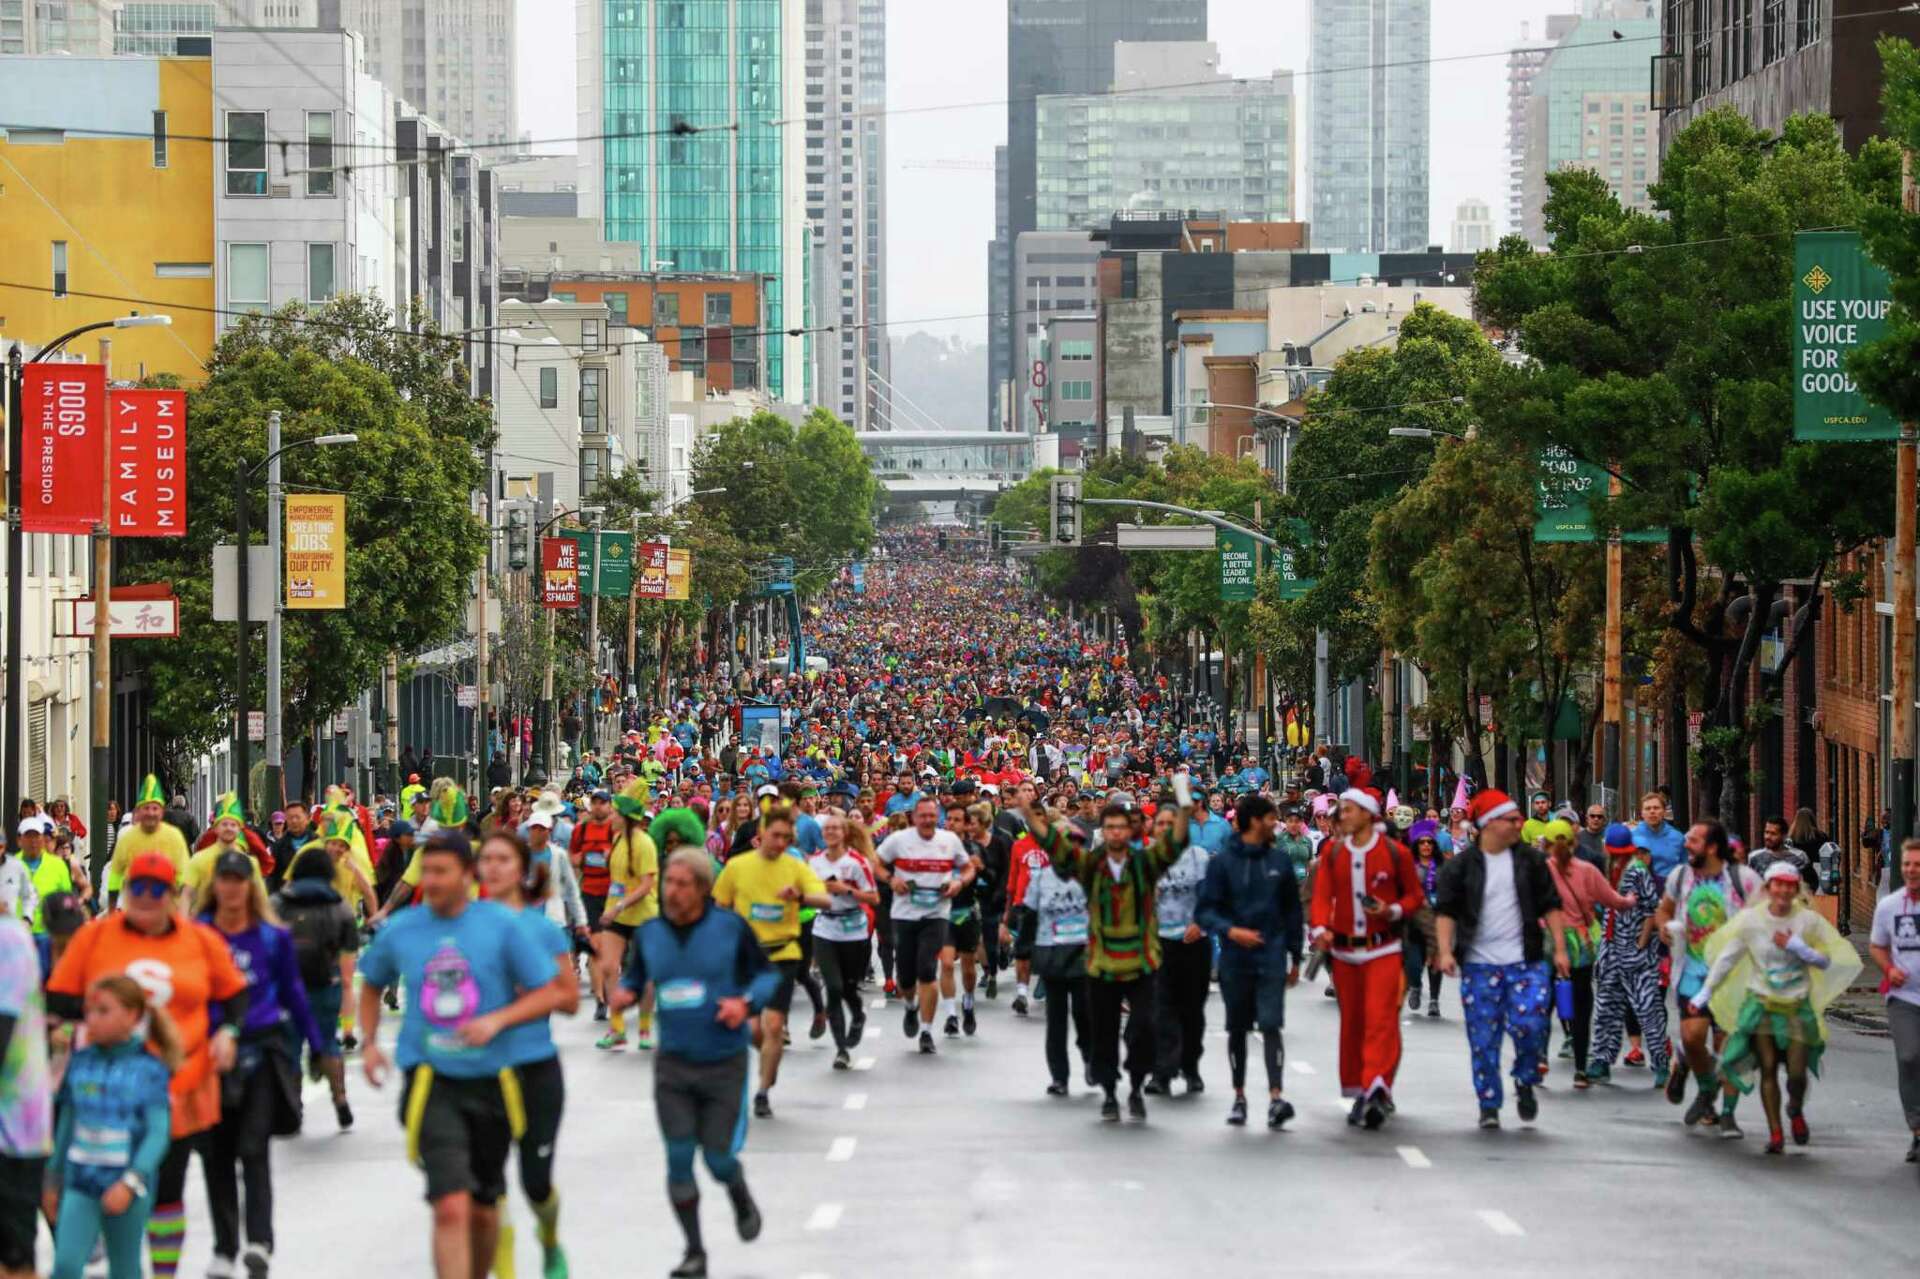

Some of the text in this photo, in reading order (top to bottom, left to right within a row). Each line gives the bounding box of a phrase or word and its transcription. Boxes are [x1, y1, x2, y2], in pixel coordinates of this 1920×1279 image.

[1802, 300, 1837, 320] USE
[1802, 324, 1857, 344] VOICE
[1802, 349, 1838, 368] FOR
[58, 381, 86, 436] DOGS
[1824, 416, 1867, 424] USFCA.EDU
[41, 381, 54, 505] IN THE PRESIDIO
[120, 400, 138, 526] FAMILY
[157, 400, 175, 526] MUSEUM
[289, 505, 334, 514] EMPOWERING
[290, 522, 334, 534] CREATING
[560, 545, 575, 557] WE
[654, 549, 665, 558] WE
[1222, 552, 1248, 560] BECOME
[289, 560, 309, 572] OUR
[557, 557, 575, 569] ARE
[650, 559, 665, 567] ARE
[1229, 560, 1252, 568] BETTER
[1223, 577, 1235, 585] DAY
[641, 585, 663, 593] SFMADE
[546, 592, 576, 602] SFMADE
